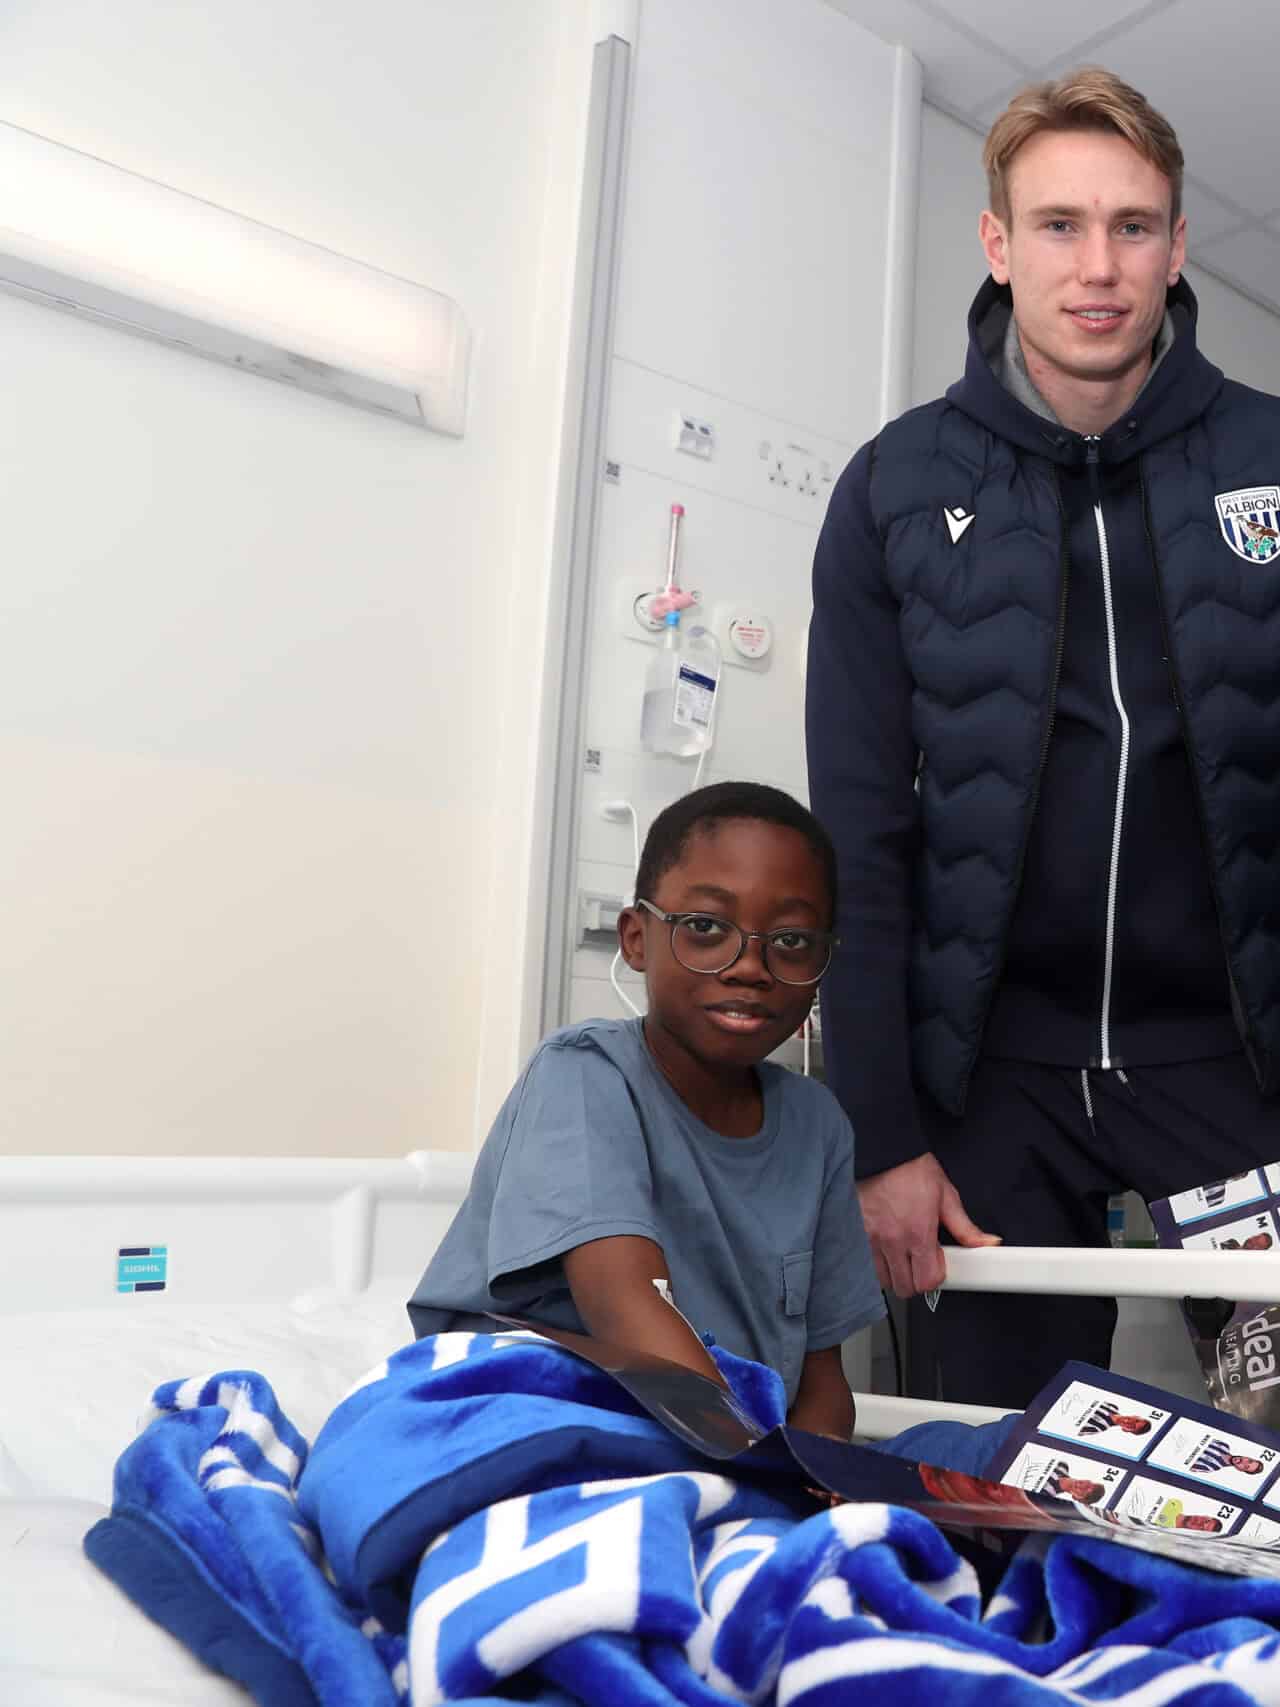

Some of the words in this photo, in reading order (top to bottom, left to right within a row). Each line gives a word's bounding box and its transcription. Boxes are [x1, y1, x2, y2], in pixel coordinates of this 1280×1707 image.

[1225, 498, 1277, 515] ALBION
[1149, 1410, 1164, 1420] 31
[1260, 1449, 1276, 1462] 22
[1103, 1468, 1119, 1482] 34
[1217, 1505, 1234, 1519] 23
